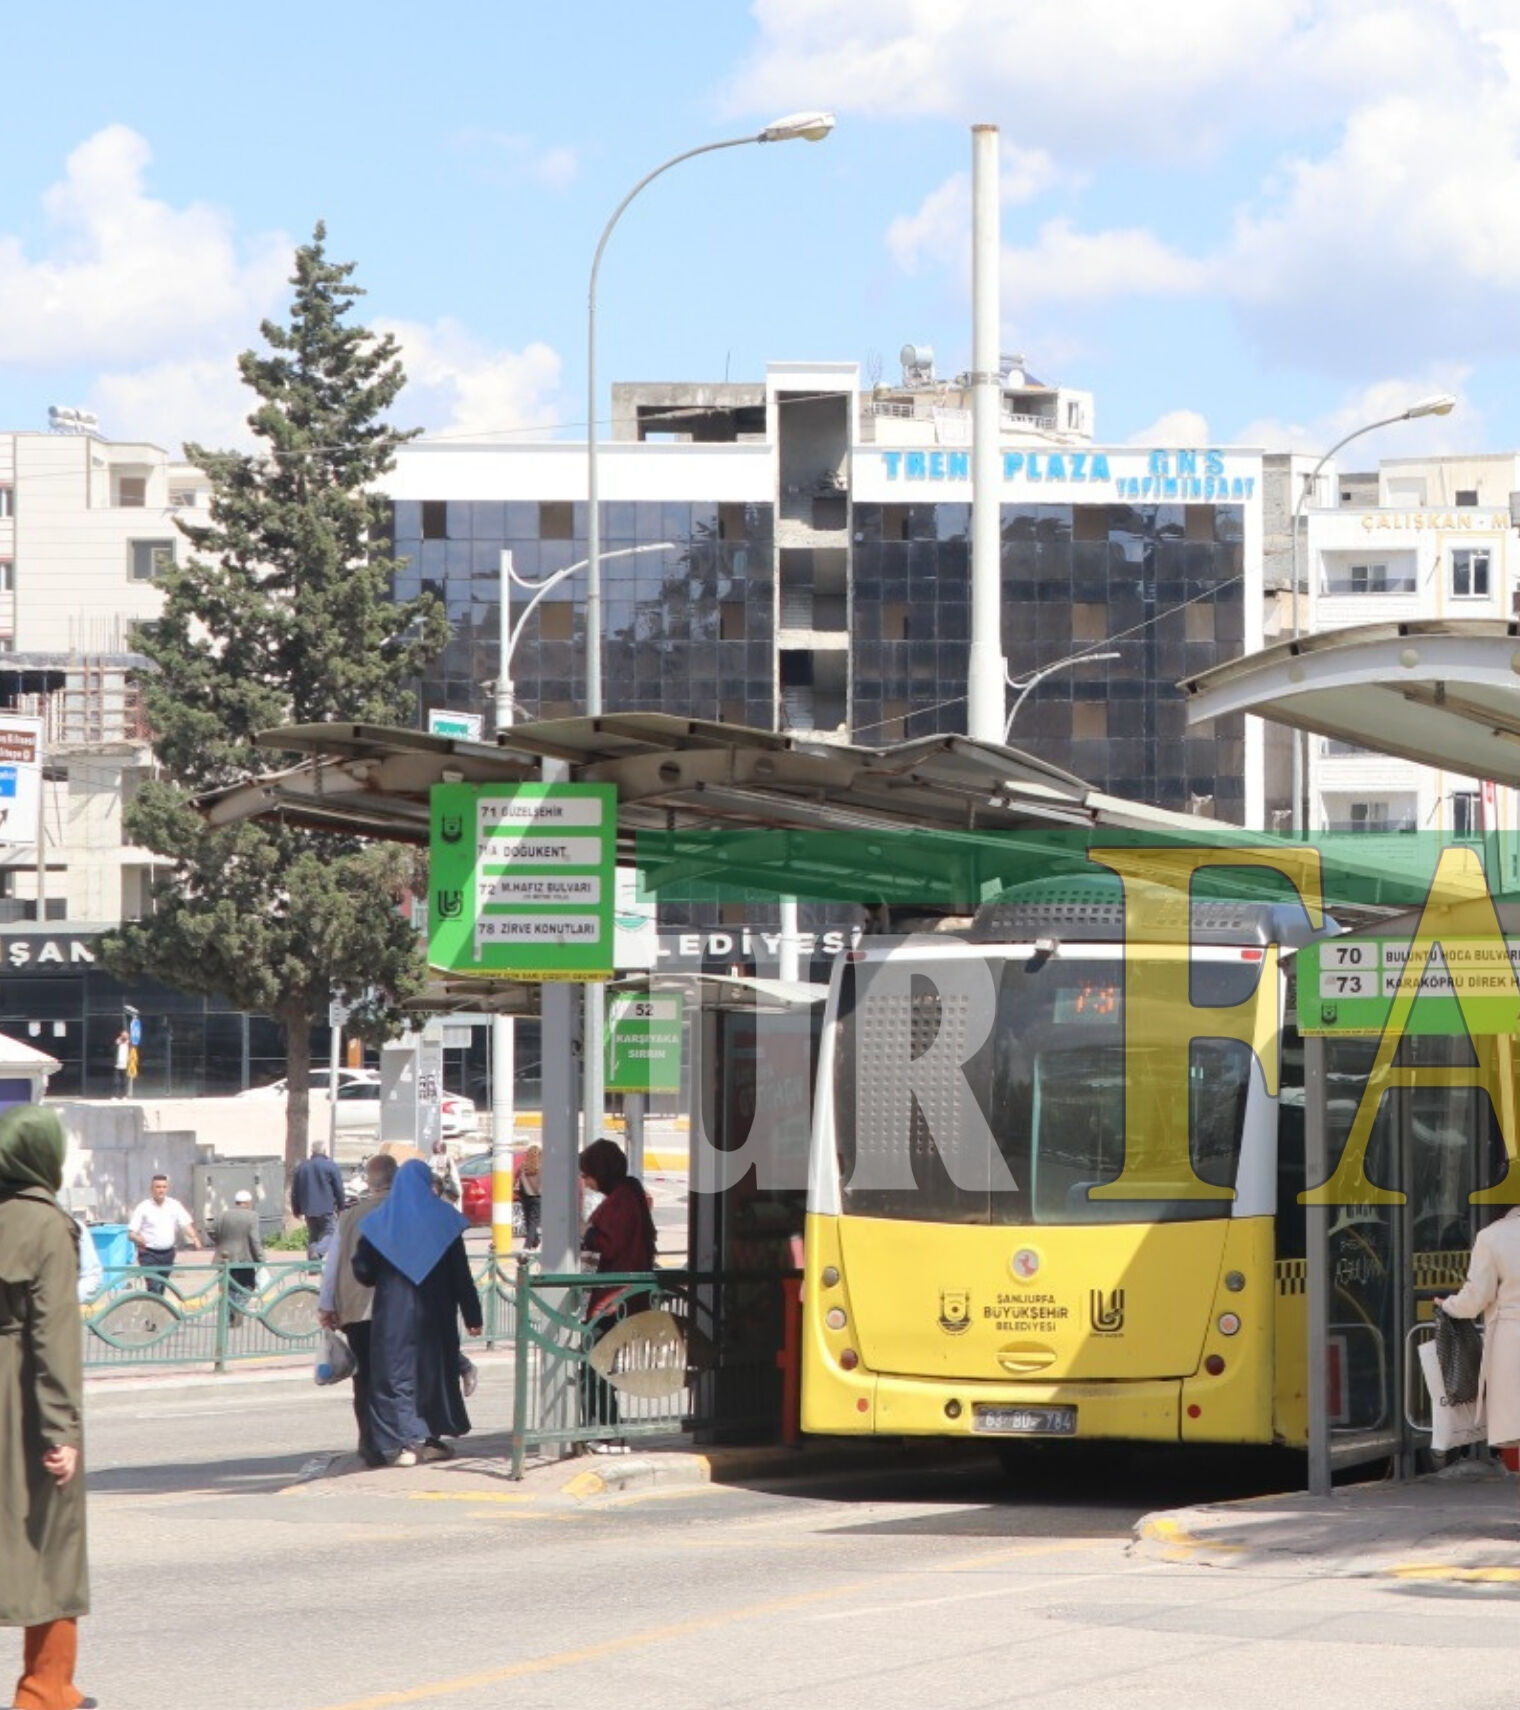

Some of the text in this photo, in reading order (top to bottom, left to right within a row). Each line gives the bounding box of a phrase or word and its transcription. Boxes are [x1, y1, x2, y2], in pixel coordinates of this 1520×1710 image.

[882, 452, 1111, 481] TREN PLAZA
[1361, 512, 1471, 533] ÇALIŞKAN
[481, 806, 497, 817] 71
[503, 844, 567, 857] DOĞUKENT
[479, 884, 496, 896] 72
[547, 883, 592, 893] BULVARI
[478, 921, 595, 934] 78 ZİRVE KONUTLARI
[1336, 948, 1362, 964] 70
[1385, 949, 1437, 963] BULUNTU
[1442, 949, 1472, 962] HOCA
[1336, 976, 1362, 993] 73
[1385, 974, 1464, 989] KARAKÖPRÜ
[1467, 973, 1512, 988] DİREK
[635, 1003, 654, 1016] 52
[984, 1306, 1069, 1320] BÜYÜKŞEHİR
